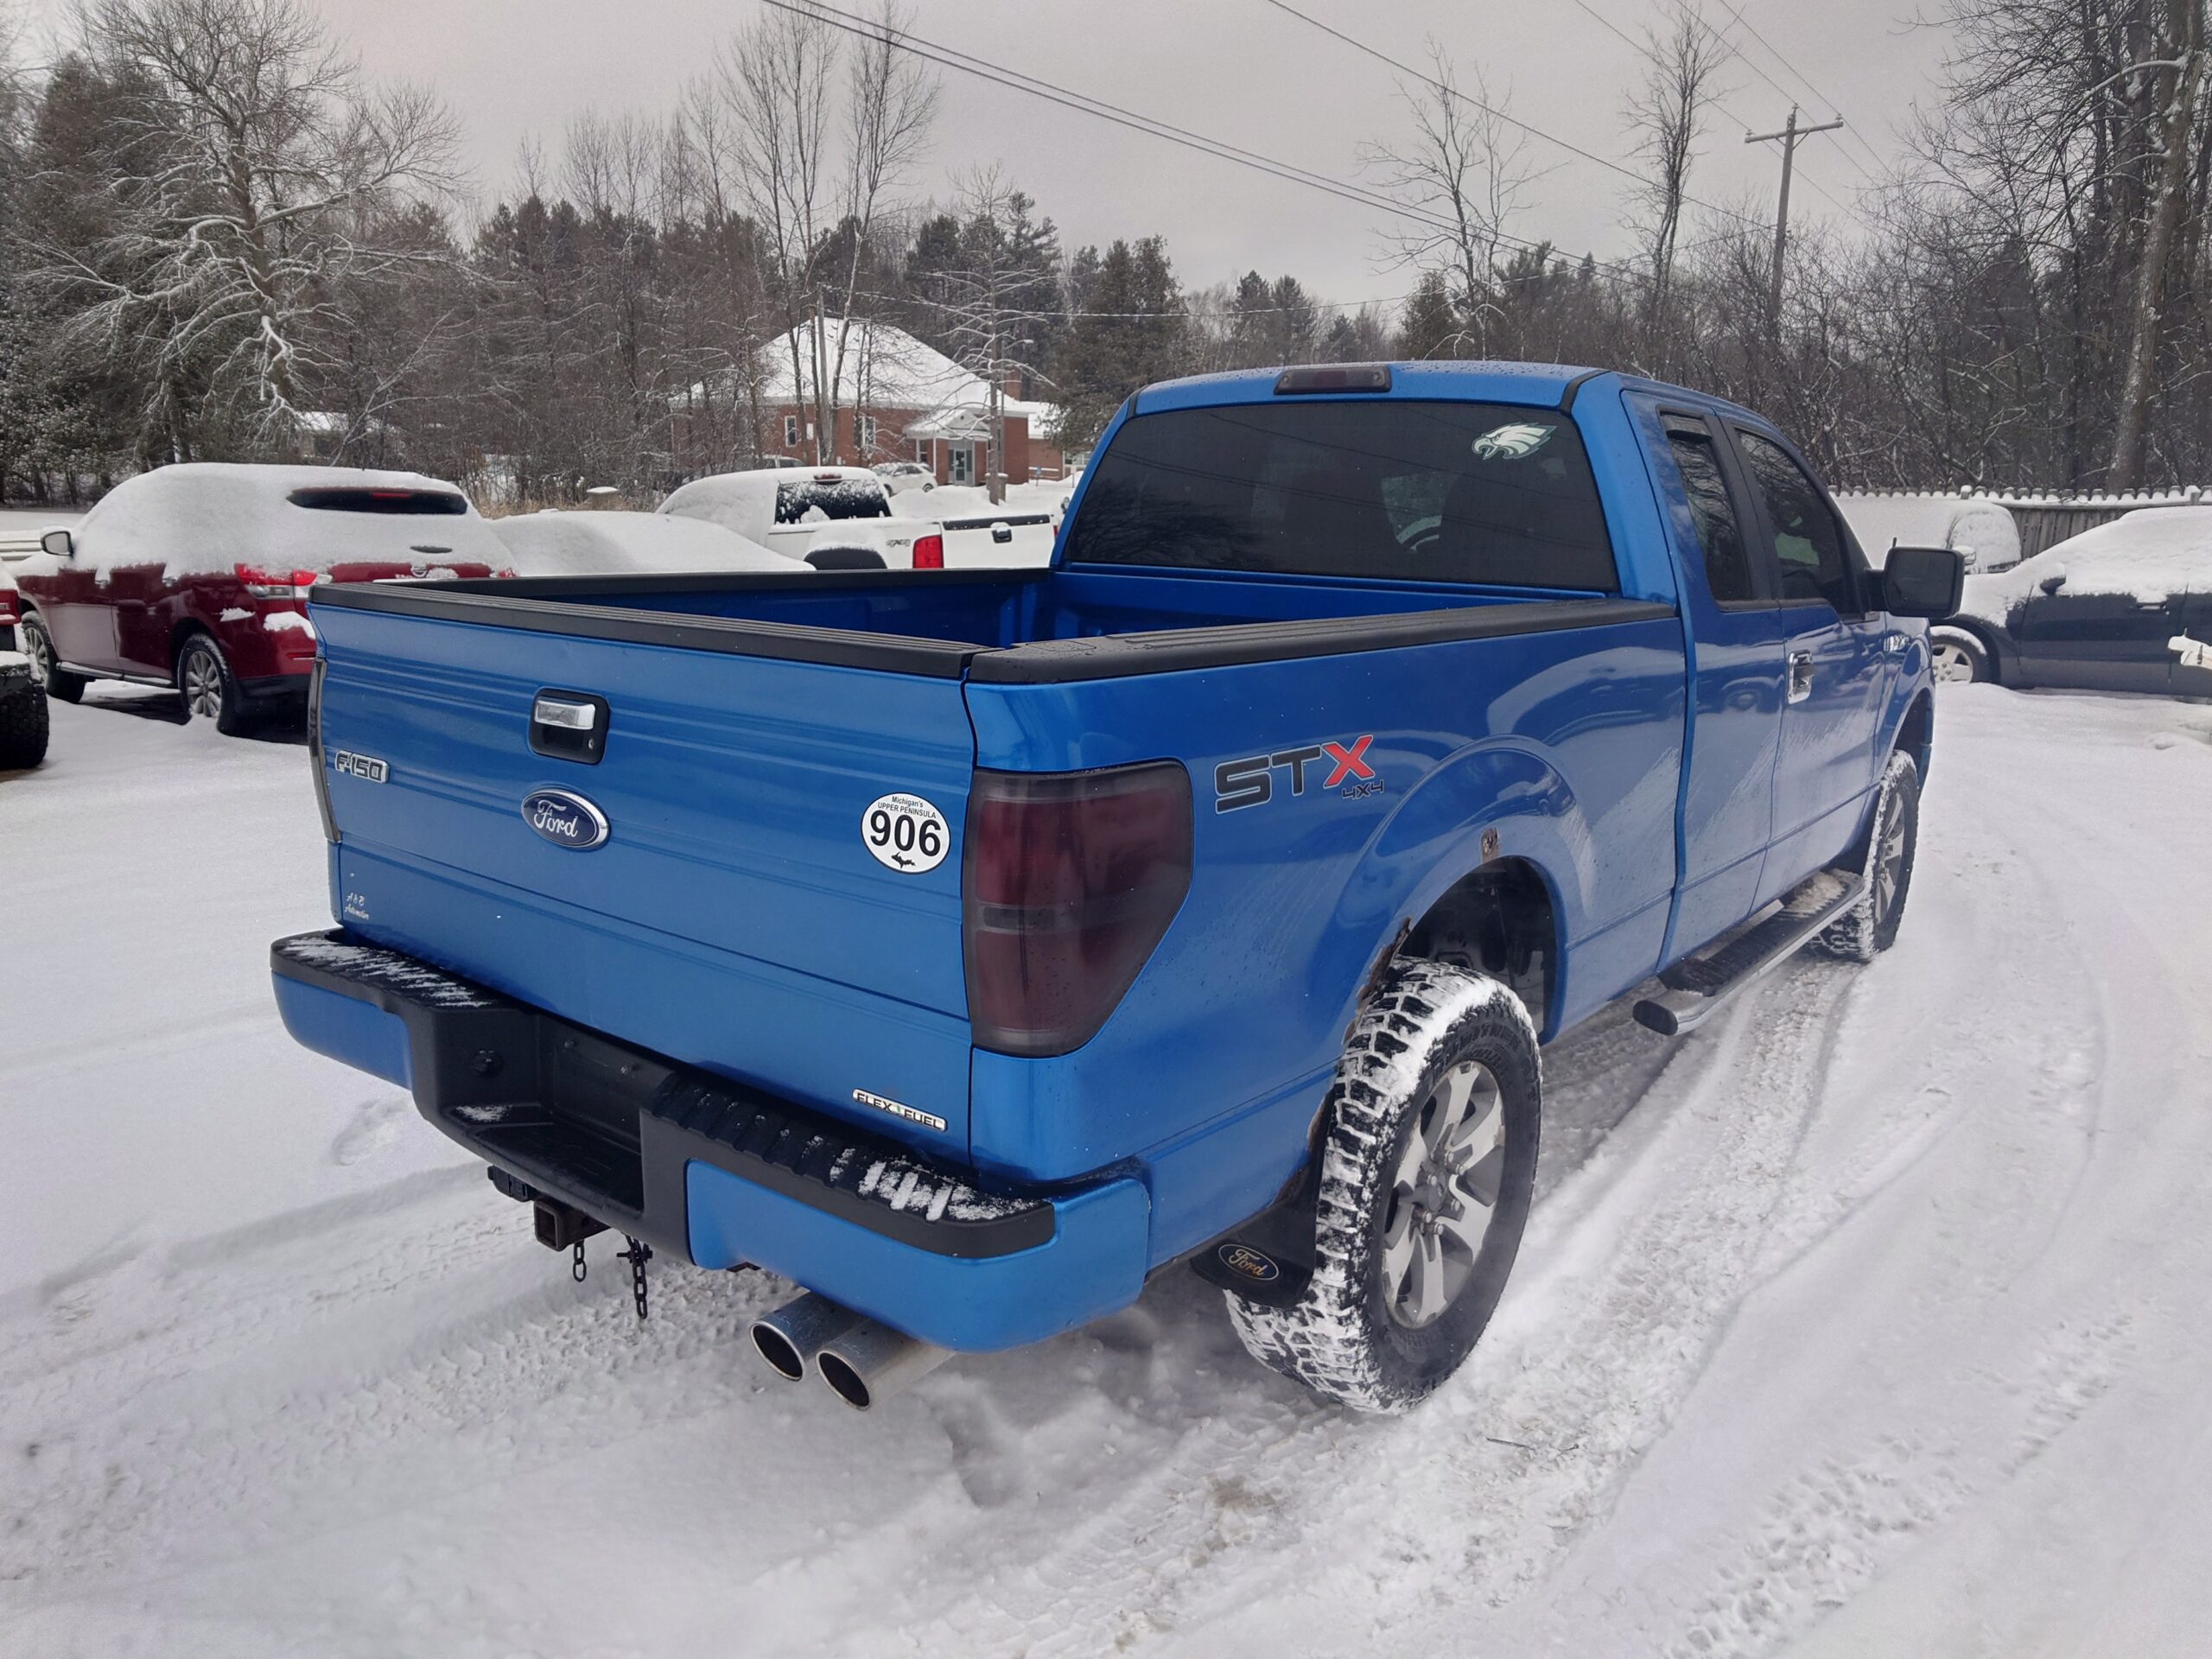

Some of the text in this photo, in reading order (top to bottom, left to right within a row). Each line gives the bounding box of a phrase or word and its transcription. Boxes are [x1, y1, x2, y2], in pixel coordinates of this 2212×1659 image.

[335, 751, 386, 783] F-150
[1214, 734, 1376, 814] STX
[891, 796, 924, 808] Michigan's
[1342, 779, 1384, 800] 4X4
[533, 799, 579, 838] Ford
[877, 801, 937, 819] UPPER PENINSULA
[870, 810, 942, 857] 906
[856, 1092, 942, 1130] FLEX FUEL
[1228, 1249, 1268, 1276] Ford
